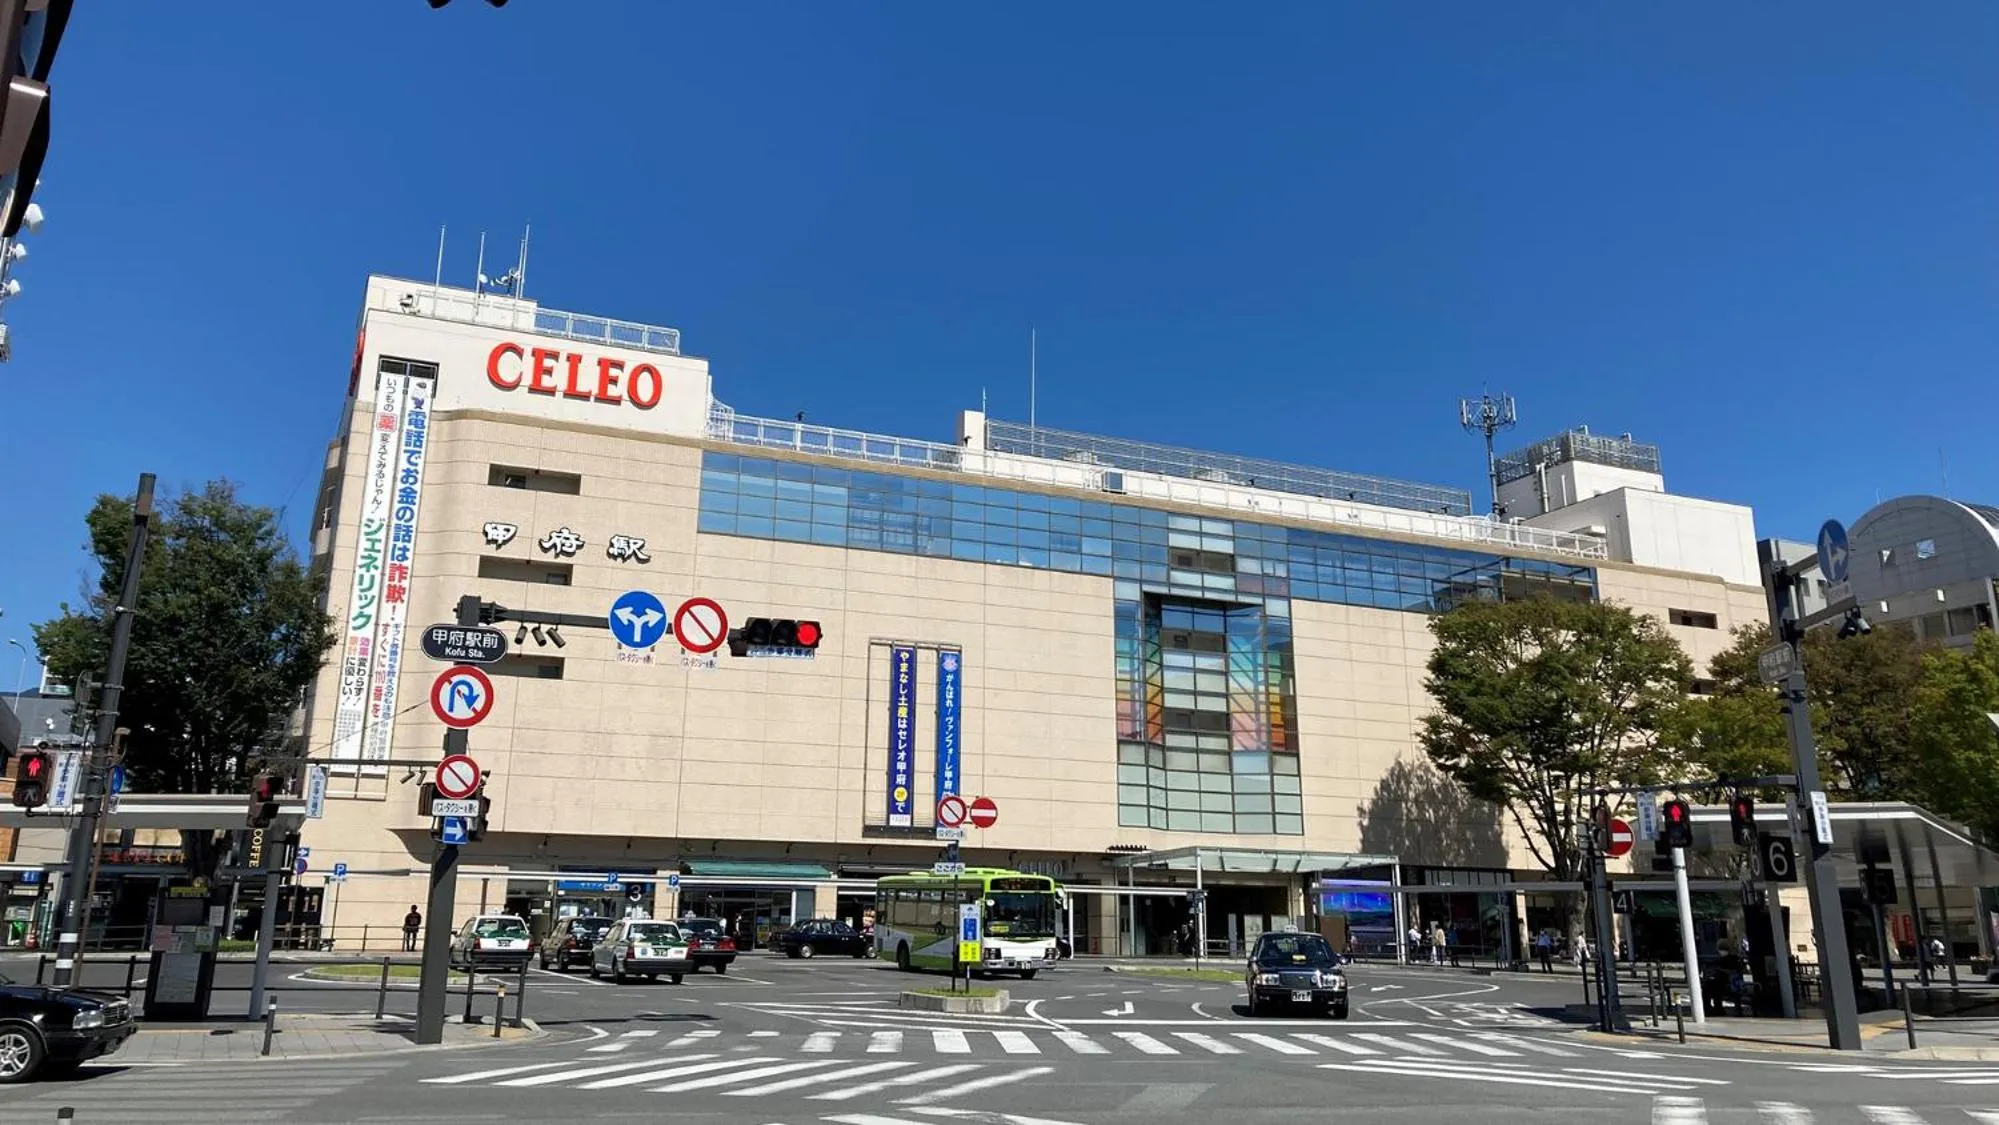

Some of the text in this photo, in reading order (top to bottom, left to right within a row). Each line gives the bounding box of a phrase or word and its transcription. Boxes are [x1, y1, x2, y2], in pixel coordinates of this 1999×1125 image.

[487, 342, 663, 410] CELEO
[384, 409, 427, 621] 電話でお金の話は詐欺!
[483, 522, 652, 564] 甲府駅
[351, 517, 386, 631] ジェネリック
[432, 629, 499, 649] 甲府駅前
[445, 647, 485, 658] Kofu Sta.
[936, 864, 963, 873] ここから
[1769, 841, 1788, 877] 6
[629, 884, 642, 902] 3
[1616, 893, 1628, 913] 4
